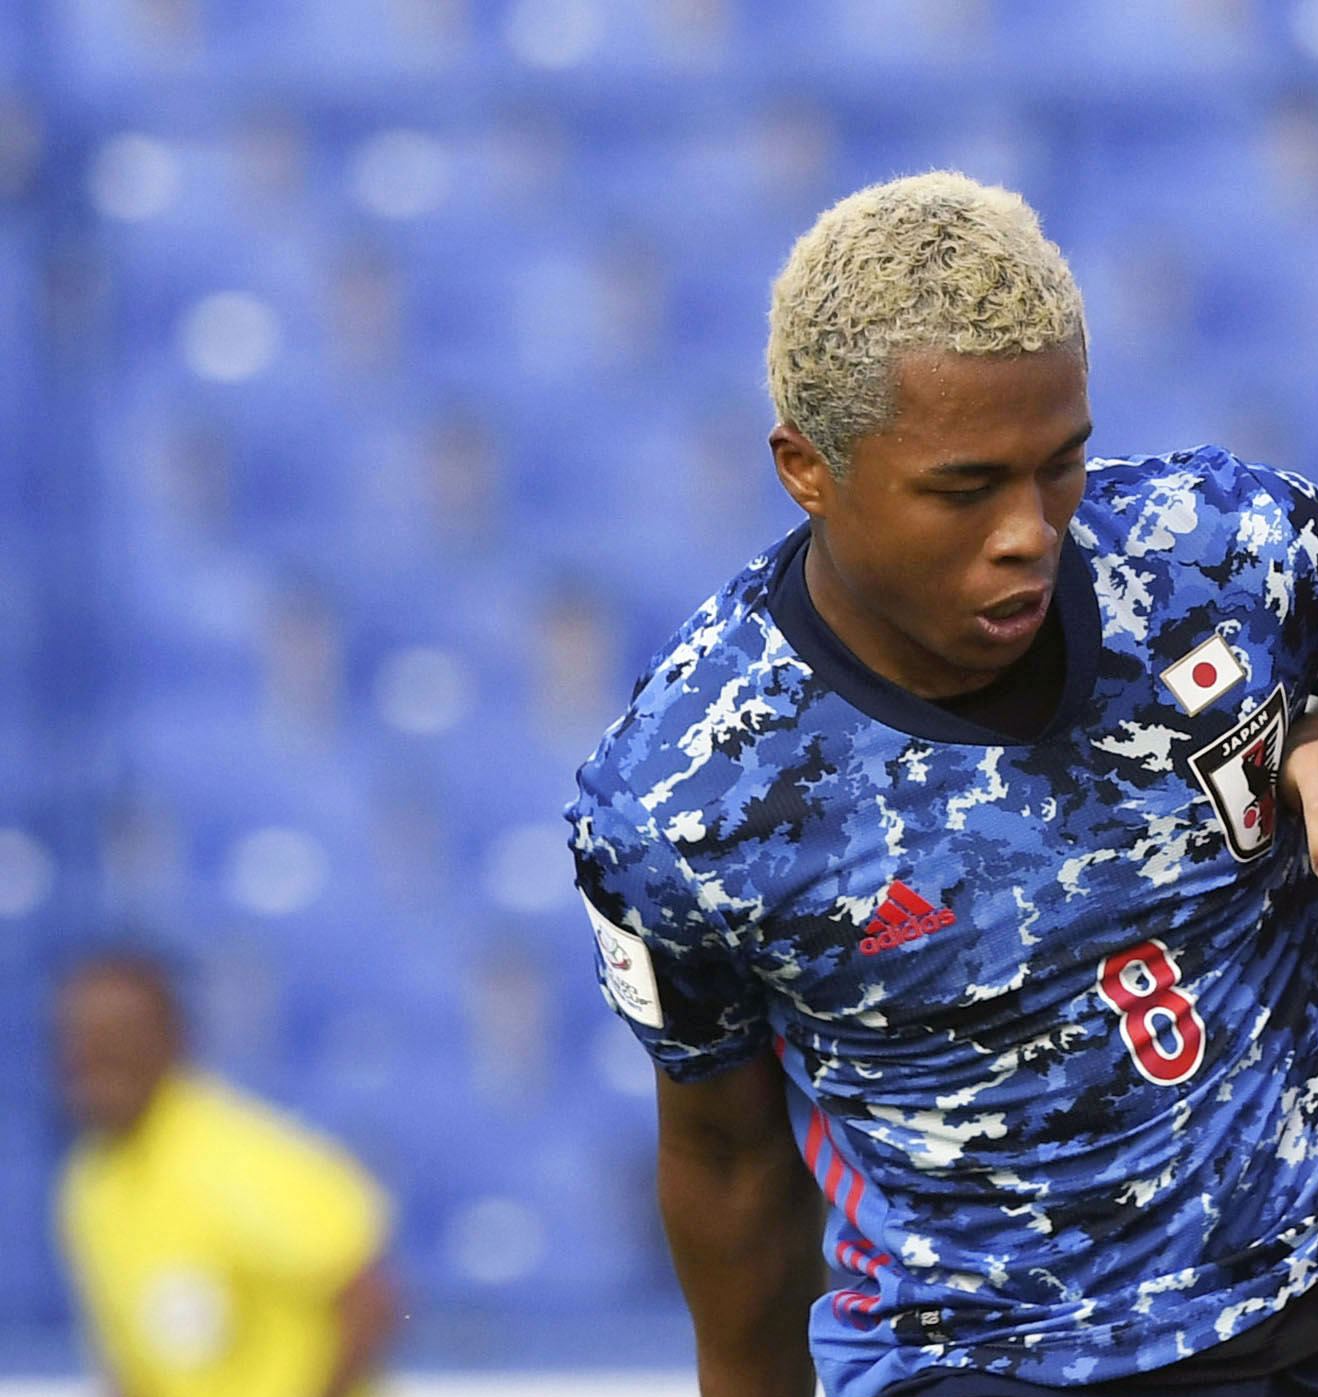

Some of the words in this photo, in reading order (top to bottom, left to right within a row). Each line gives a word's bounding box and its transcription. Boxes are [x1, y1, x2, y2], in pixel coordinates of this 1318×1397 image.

[1222, 710, 1270, 757] JAPAN
[859, 909, 957, 956] adidas
[1096, 938, 1206, 1086] 8
